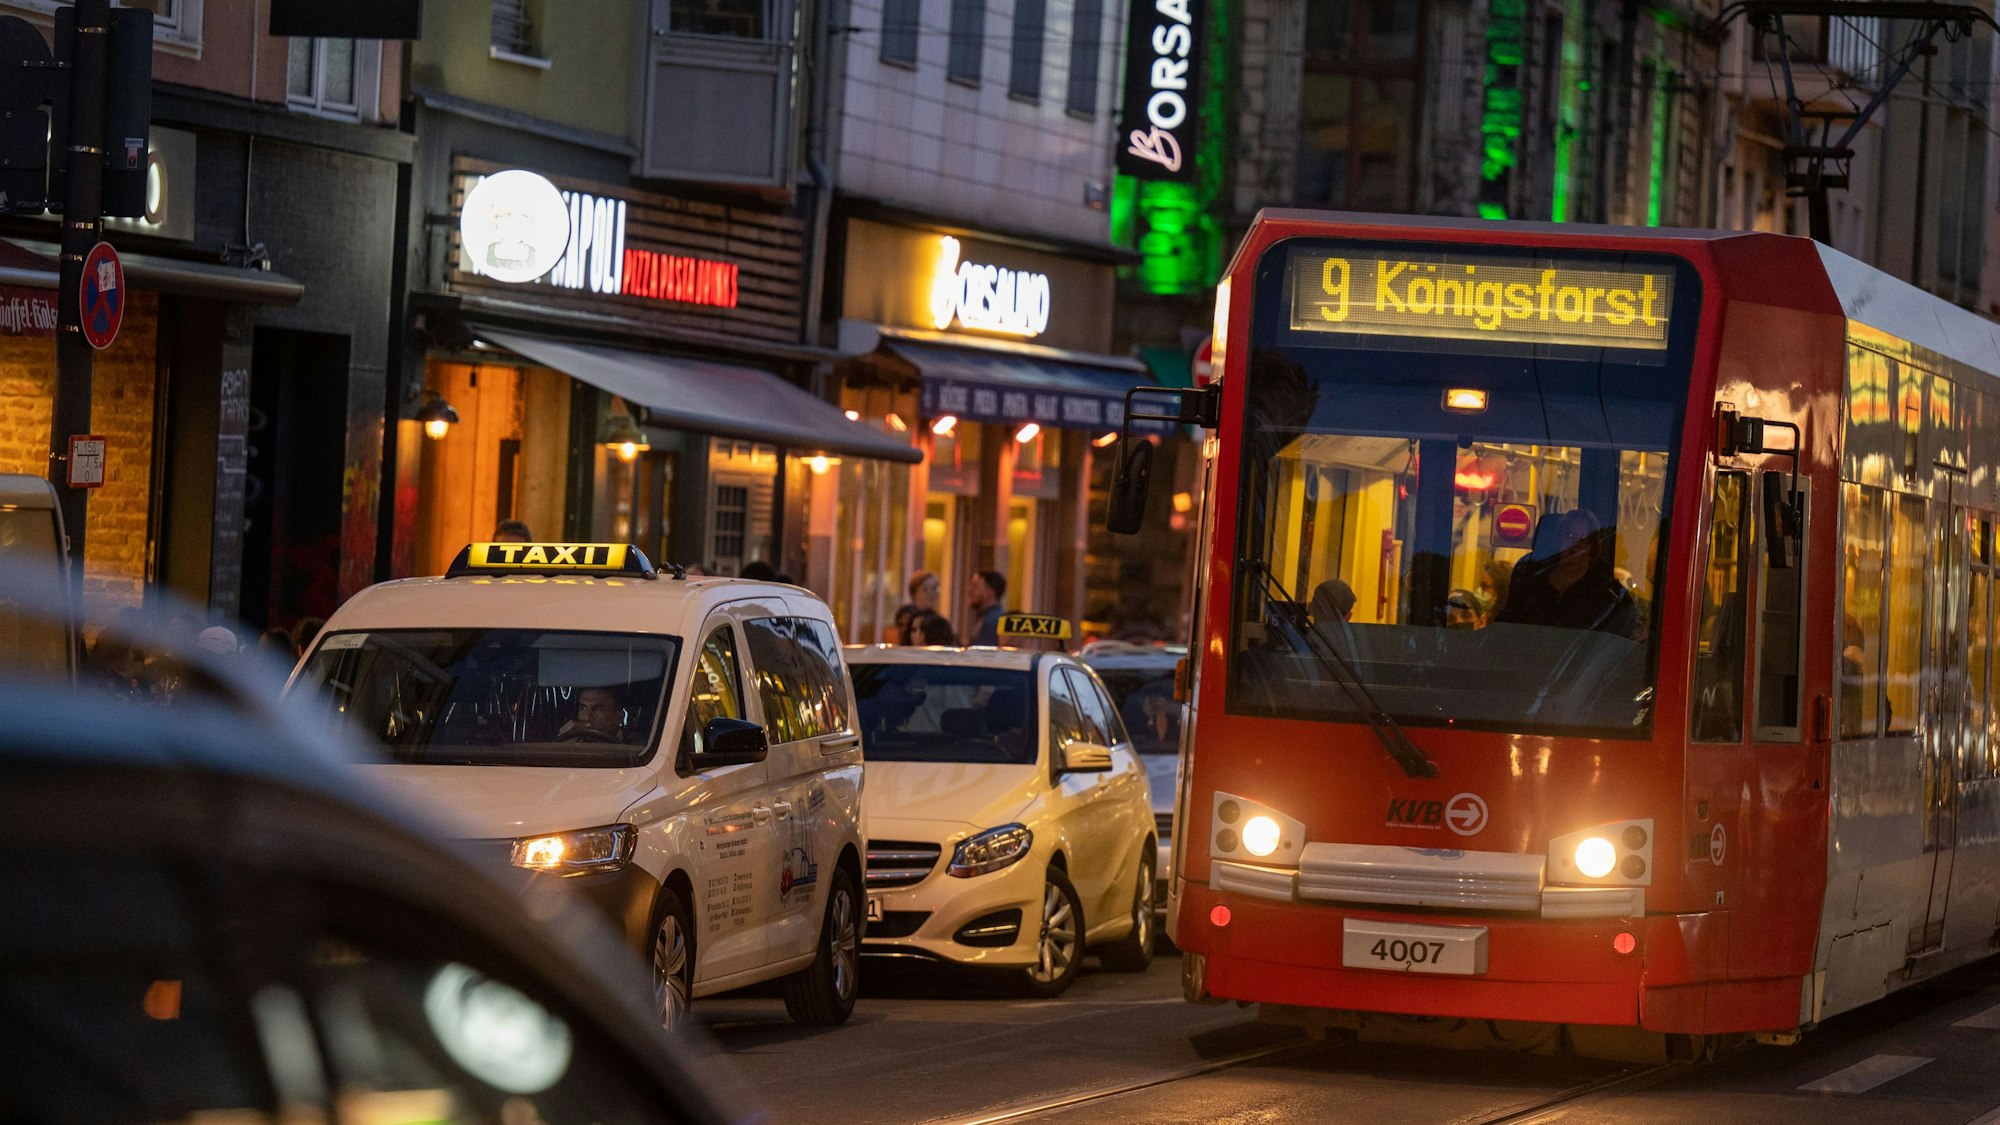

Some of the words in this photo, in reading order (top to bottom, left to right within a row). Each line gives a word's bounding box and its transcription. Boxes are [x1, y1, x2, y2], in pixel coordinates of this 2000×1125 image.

[1321, 257, 1350, 322] 9
[1375, 260, 1659, 331] Königsforst
[85, 441, 97, 453] 150
[499, 545, 596, 565] TAXI
[1009, 617, 1056, 634] TAXI
[1387, 799, 1444, 823] KVB
[1371, 939, 1445, 964] 4007
